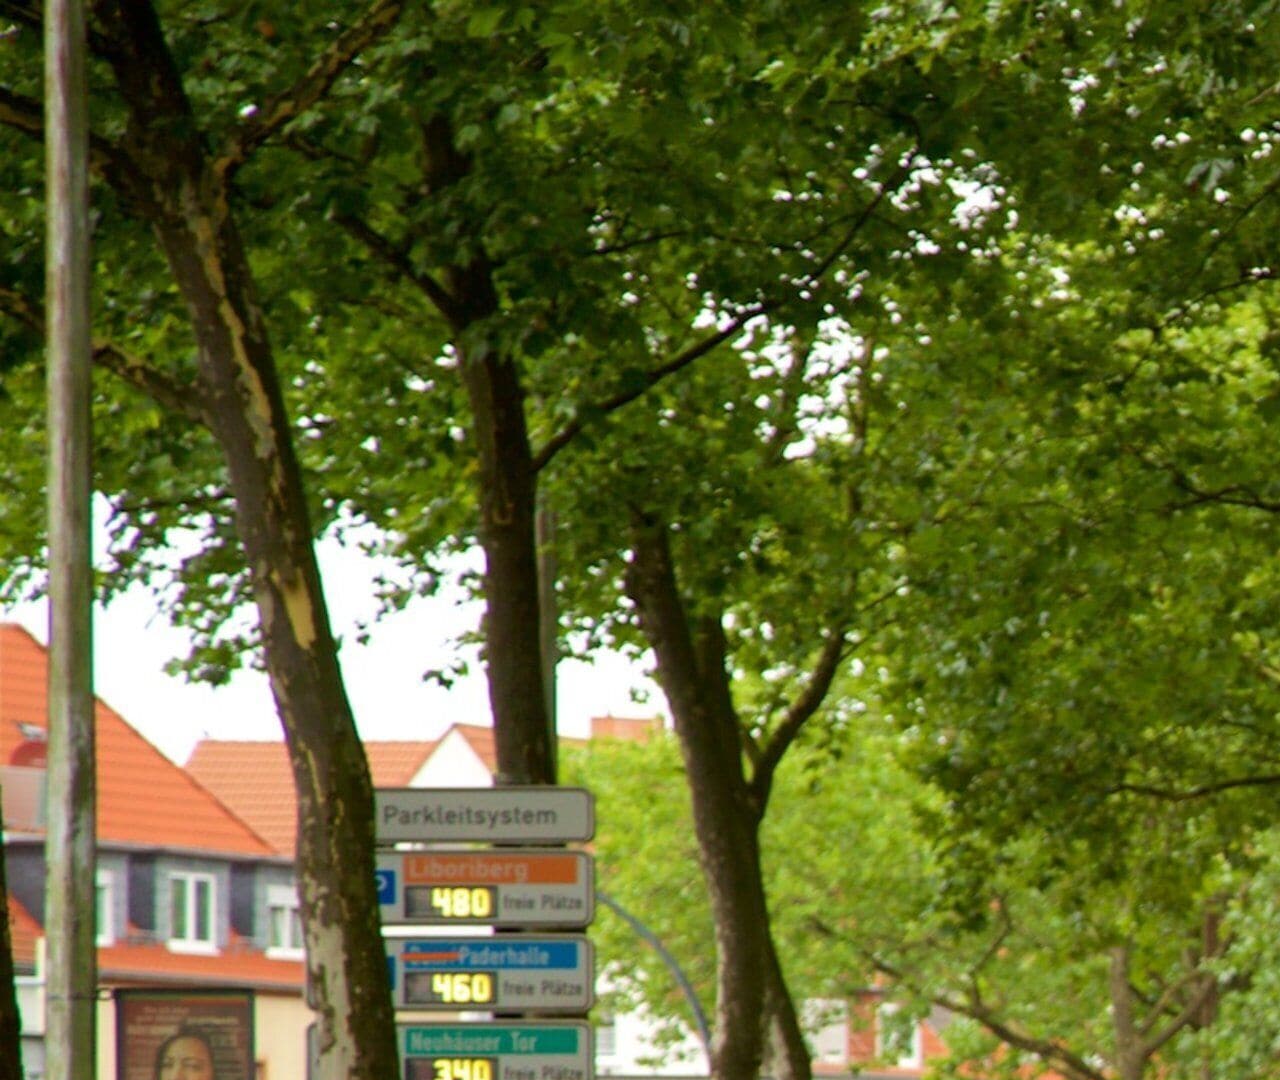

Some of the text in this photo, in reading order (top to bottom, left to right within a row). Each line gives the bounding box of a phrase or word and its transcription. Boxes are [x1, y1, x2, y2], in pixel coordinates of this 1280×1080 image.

[382, 804, 558, 829] Parkleitsystem
[409, 857, 528, 882] Liboriberg
[431, 887, 491, 917] 480
[503, 894, 535, 909] freie
[459, 945, 549, 966] Paderhalle
[432, 973, 491, 1003] 460
[503, 980, 535, 995] freie
[411, 1030, 538, 1051] Neuhäuser Tor
[504, 1066, 535, 1080] freie
